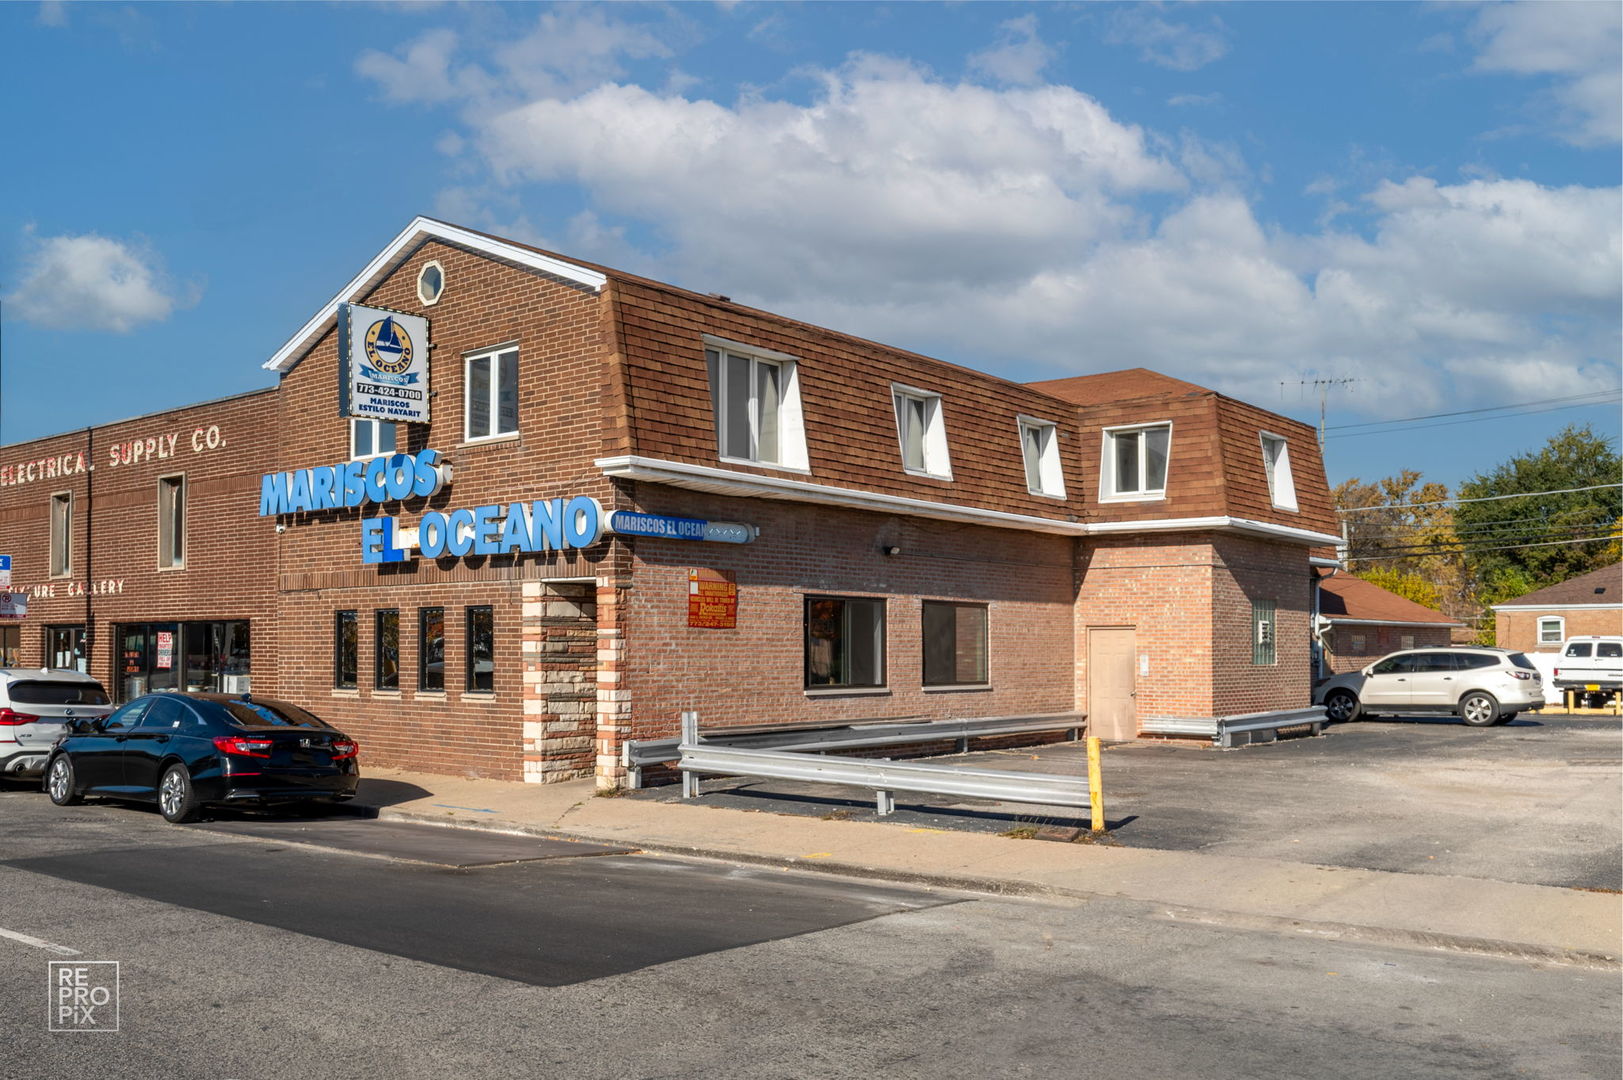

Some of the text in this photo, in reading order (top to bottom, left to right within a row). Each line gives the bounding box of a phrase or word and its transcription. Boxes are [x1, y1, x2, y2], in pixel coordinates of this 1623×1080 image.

[367, 341, 411, 373] EL OCEANO
[371, 373, 408, 383] MARISCOS
[358, 384, 421, 399] 773-424-0700
[359, 404, 421, 417] ESTILO NAYARIT
[370, 398, 410, 408] MARISCOS
[0, 425, 227, 486] ELECTRICA SUPPLY CO.
[260, 450, 440, 516] MARISCOS
[362, 496, 600, 564] EL OCEANO
[615, 515, 665, 534] MARISCOS
[667, 520, 677, 535] EL
[68, 579, 125, 596] GALERY
